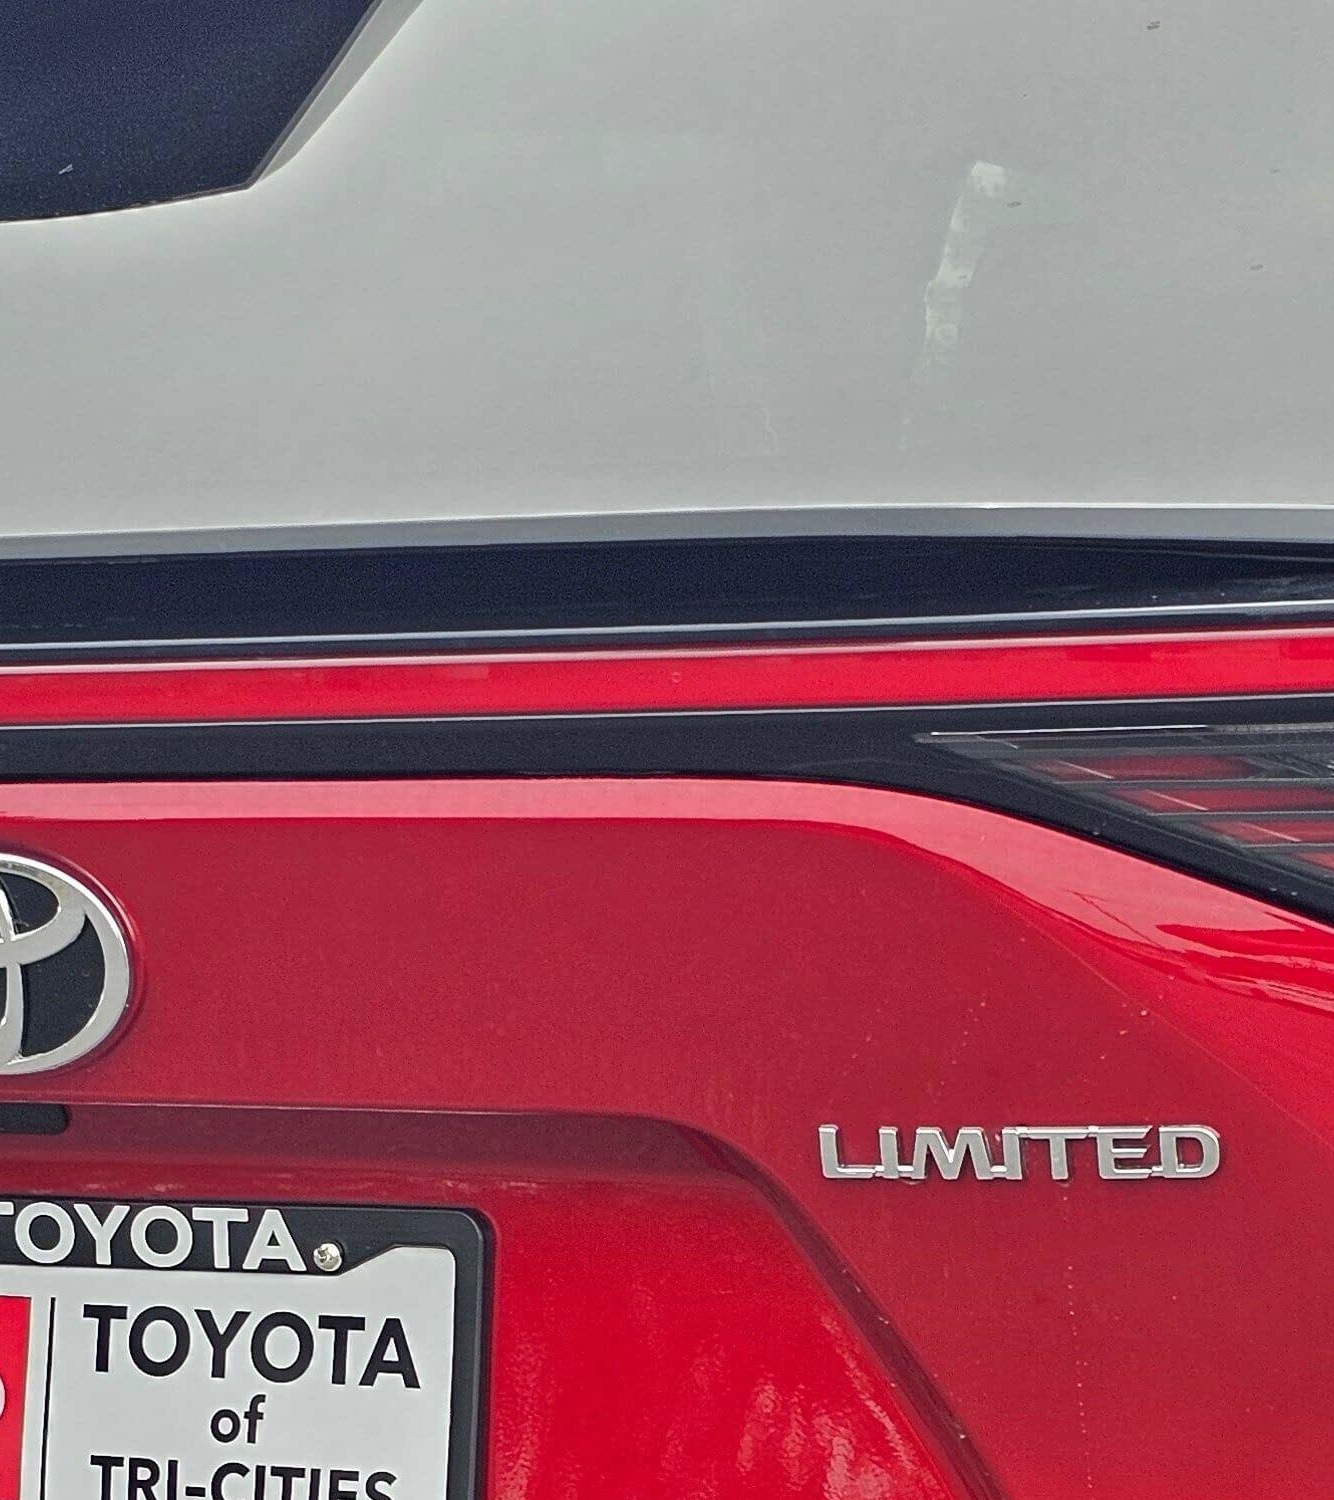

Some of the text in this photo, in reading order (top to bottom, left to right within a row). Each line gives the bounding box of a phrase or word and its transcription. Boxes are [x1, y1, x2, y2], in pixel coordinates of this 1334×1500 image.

[819, 1125, 1221, 1181] LIMITED
[83, 1304, 421, 1389] TOYOTA
[210, 1395, 266, 1444] of
